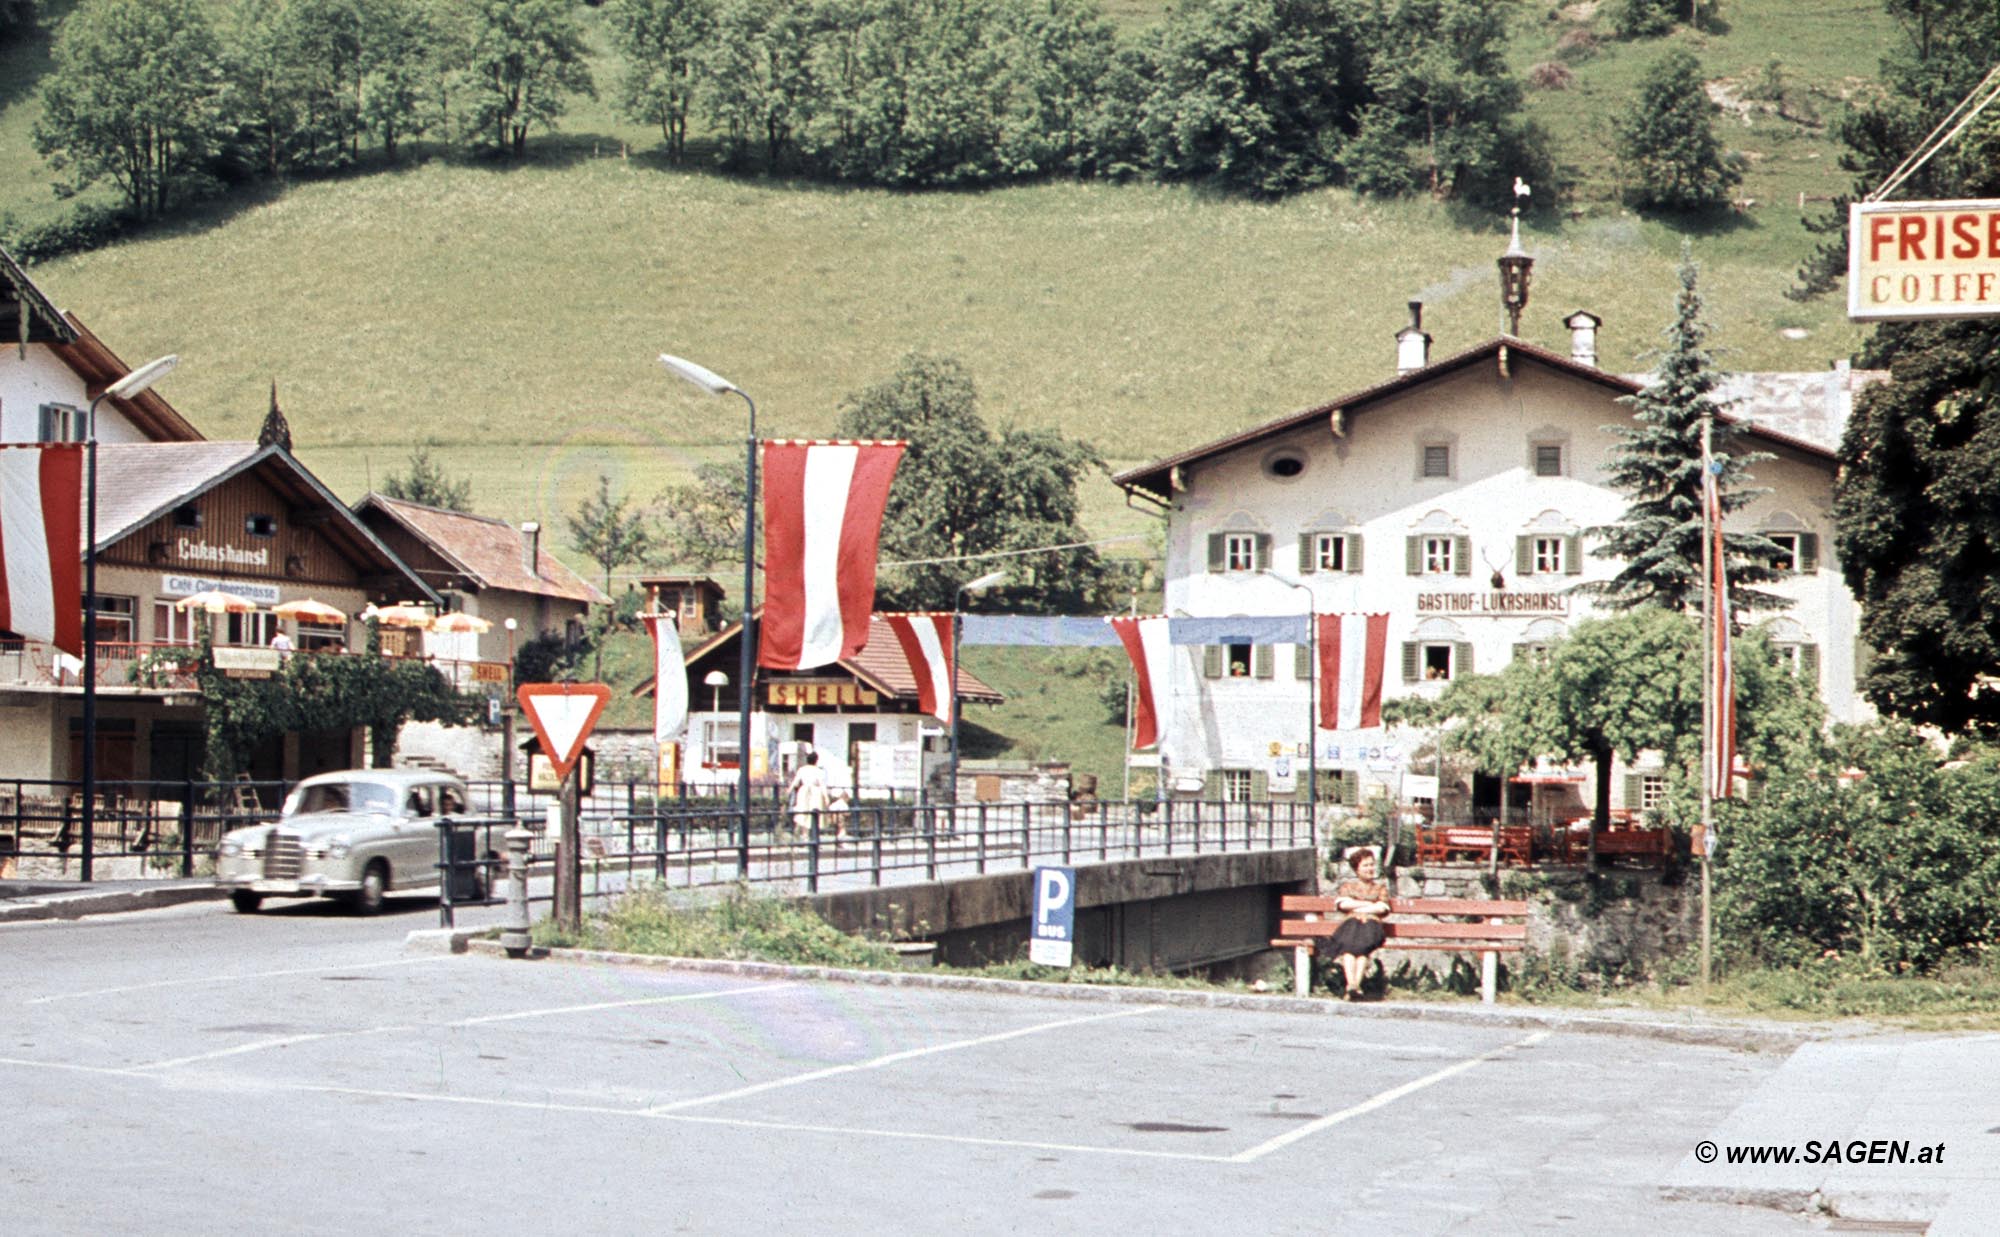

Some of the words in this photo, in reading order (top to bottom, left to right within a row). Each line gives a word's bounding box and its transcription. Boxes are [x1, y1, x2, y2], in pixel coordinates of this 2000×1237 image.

[1870, 212, 2000, 261] FRISE
[1871, 272, 1996, 303] COIFF
[178, 537, 268, 566] Lukashansl
[169, 577, 192, 592] Café
[476, 664, 502, 680] SHELL
[777, 684, 864, 705] SHELL
[1038, 869, 1070, 924] P
[1038, 924, 1067, 939] BUS
